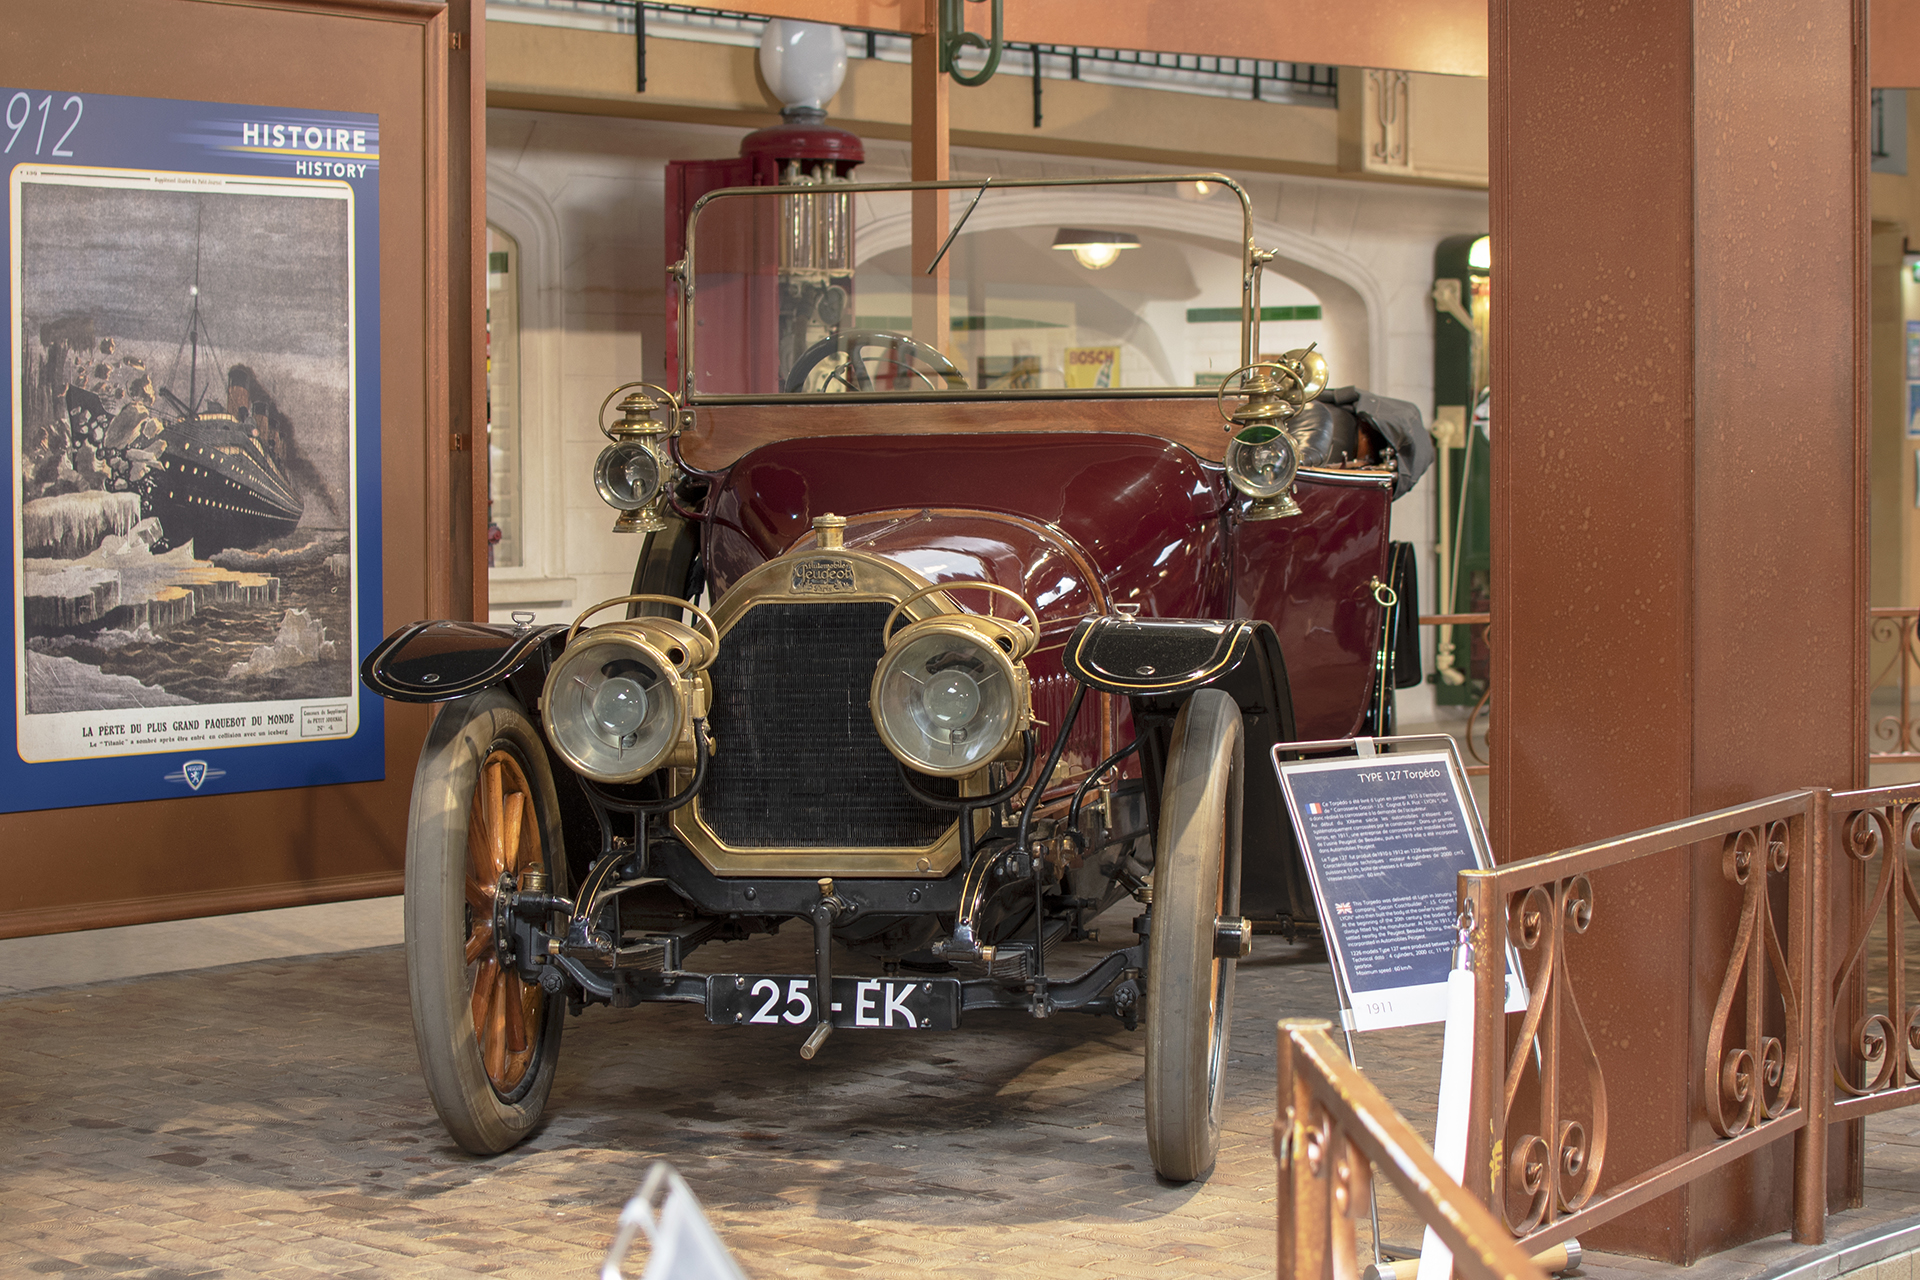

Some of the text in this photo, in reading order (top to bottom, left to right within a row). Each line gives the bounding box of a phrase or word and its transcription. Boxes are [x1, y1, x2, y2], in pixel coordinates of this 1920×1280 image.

[4, 92, 83, 157] 912
[243, 123, 366, 152] HISTOIRE
[296, 161, 366, 178] HISTORY
[1069, 350, 1114, 365] BOSCH
[797, 564, 852, 584] Peugeot
[82, 727, 93, 737] LA
[130, 724, 142, 734] DU
[147, 722, 167, 733] PLUS
[172, 720, 200, 731] GRAND
[205, 717, 246, 729] PAQUEBOT
[251, 716, 262, 726] DU
[267, 714, 294, 725] MONDE
[1357, 768, 1440, 782] TYPE 127 Torpédo
[750, 979, 812, 1024] 25
[1366, 1001, 1392, 1015] 1911
